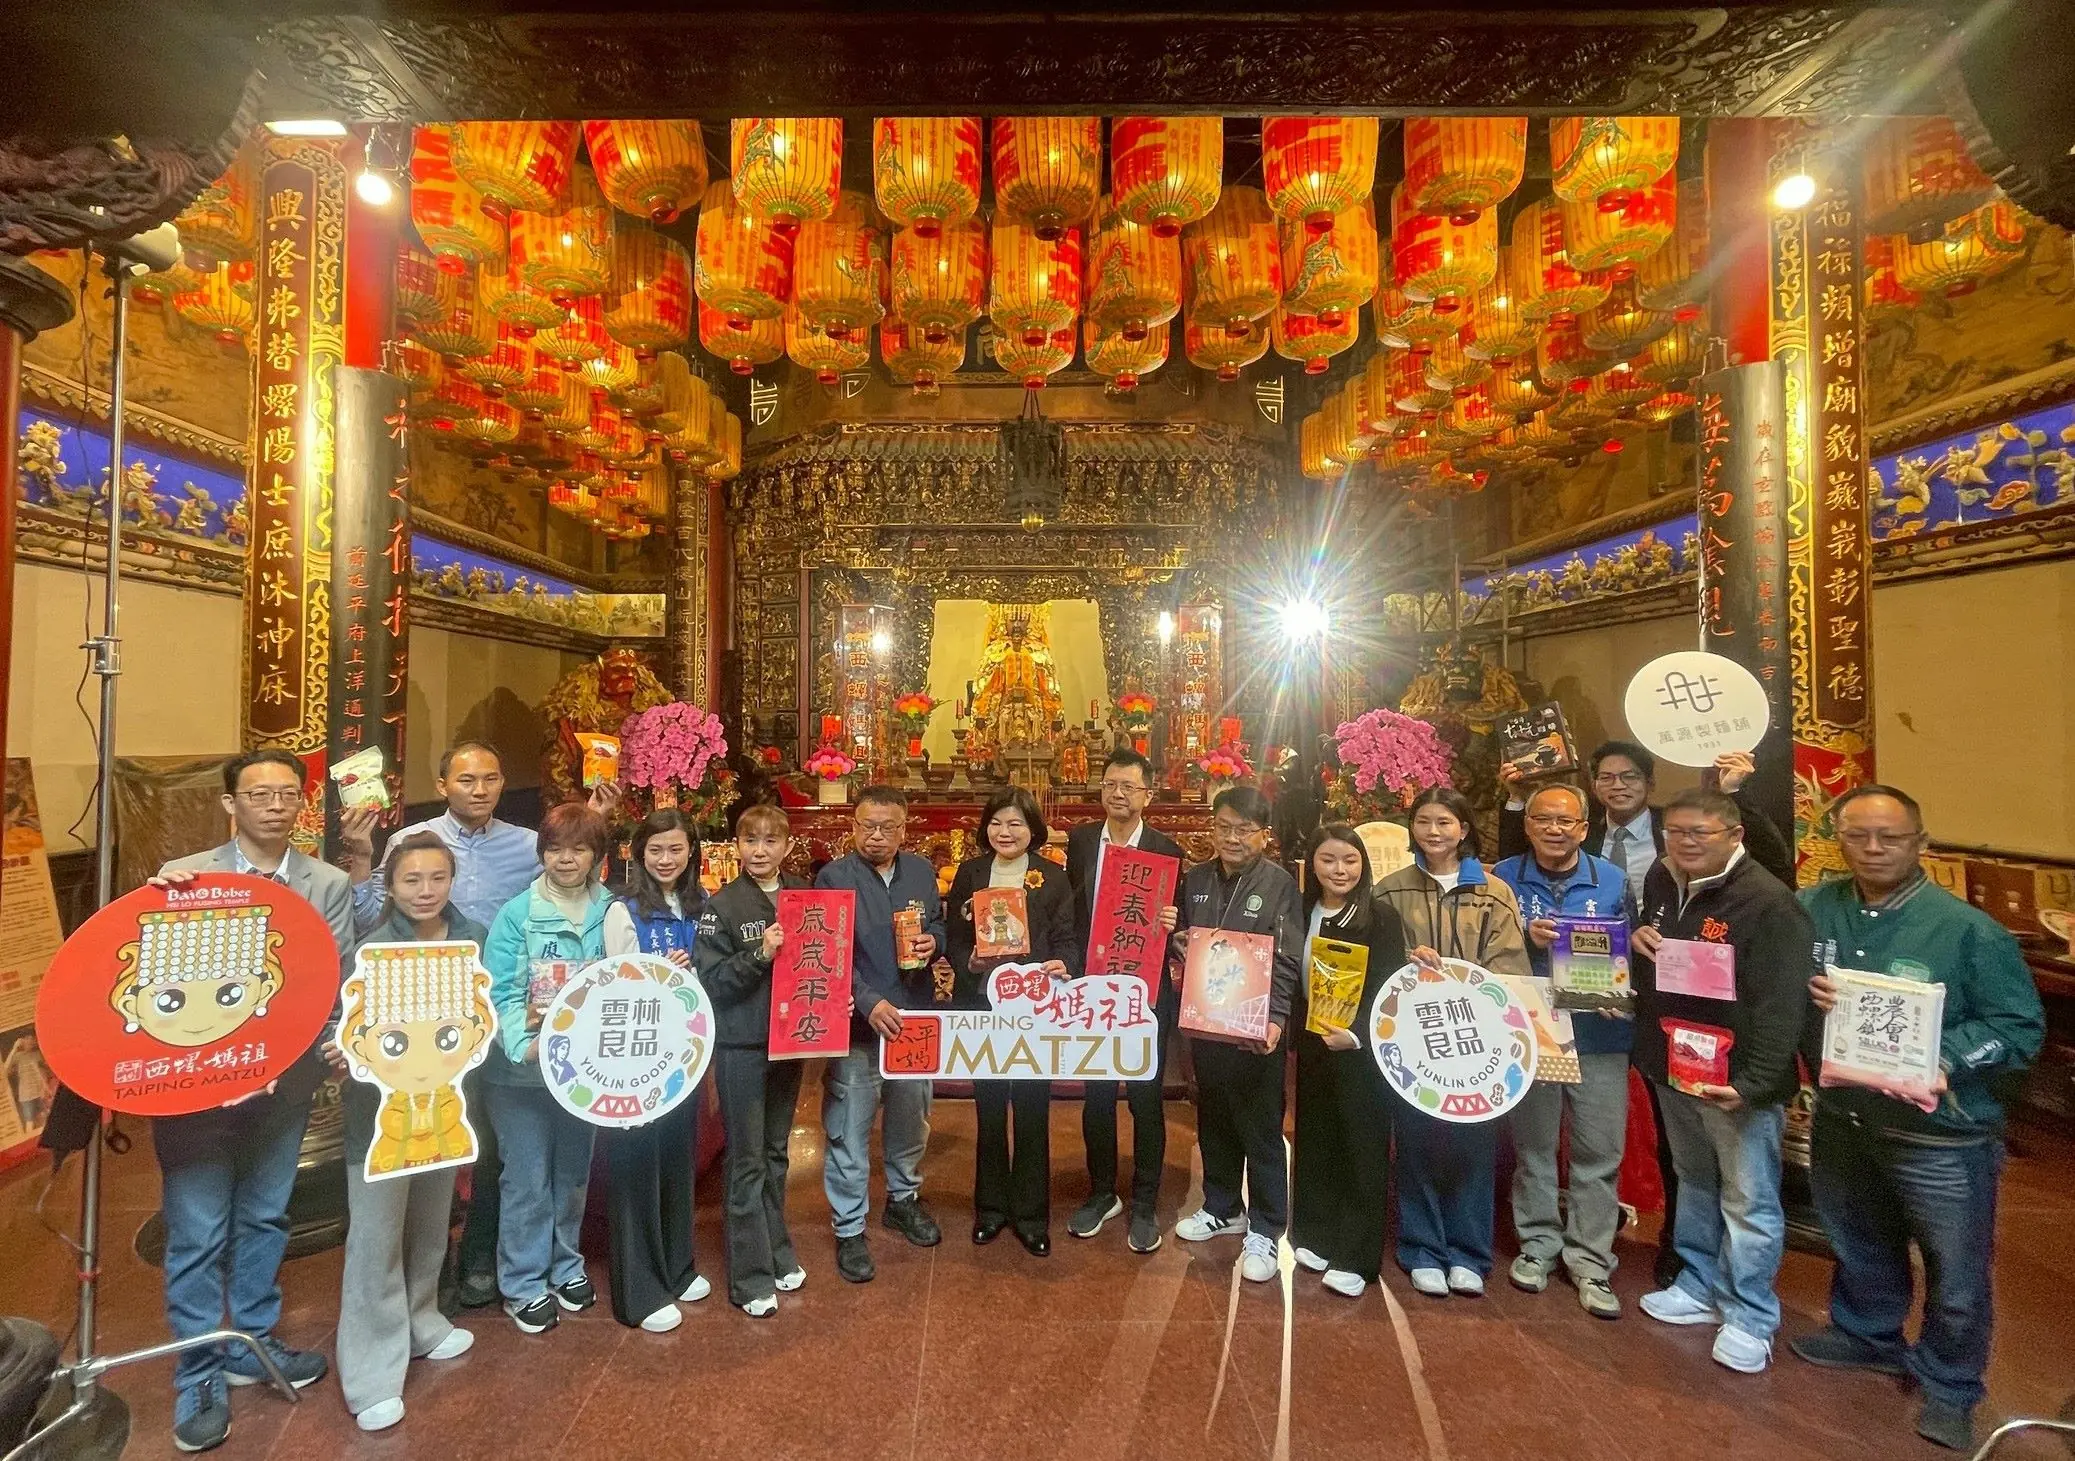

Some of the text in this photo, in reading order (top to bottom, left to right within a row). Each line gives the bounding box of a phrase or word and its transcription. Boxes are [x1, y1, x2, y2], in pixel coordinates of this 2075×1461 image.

[740, 920, 766, 939] 1717
[1701, 916, 1729, 943] 誠
[790, 903, 834, 1043] 歲歲平安
[601, 997, 662, 1027] 雲林
[1034, 981, 1151, 1031] 媽祖
[1414, 996, 1476, 1029] 雲林
[946, 1015, 1033, 1031] TAIPING
[598, 1028, 658, 1059] 良品
[944, 1034, 1151, 1077] MATZU
[1424, 1027, 1485, 1060] 良品
[145, 1042, 270, 1079] 西螺媽祖
[579, 1050, 674, 1089] YUNLIN GOODS
[1416, 1046, 1502, 1089] YUNLIN GOODS
[113, 1066, 266, 1100] TAIPING MATZU
